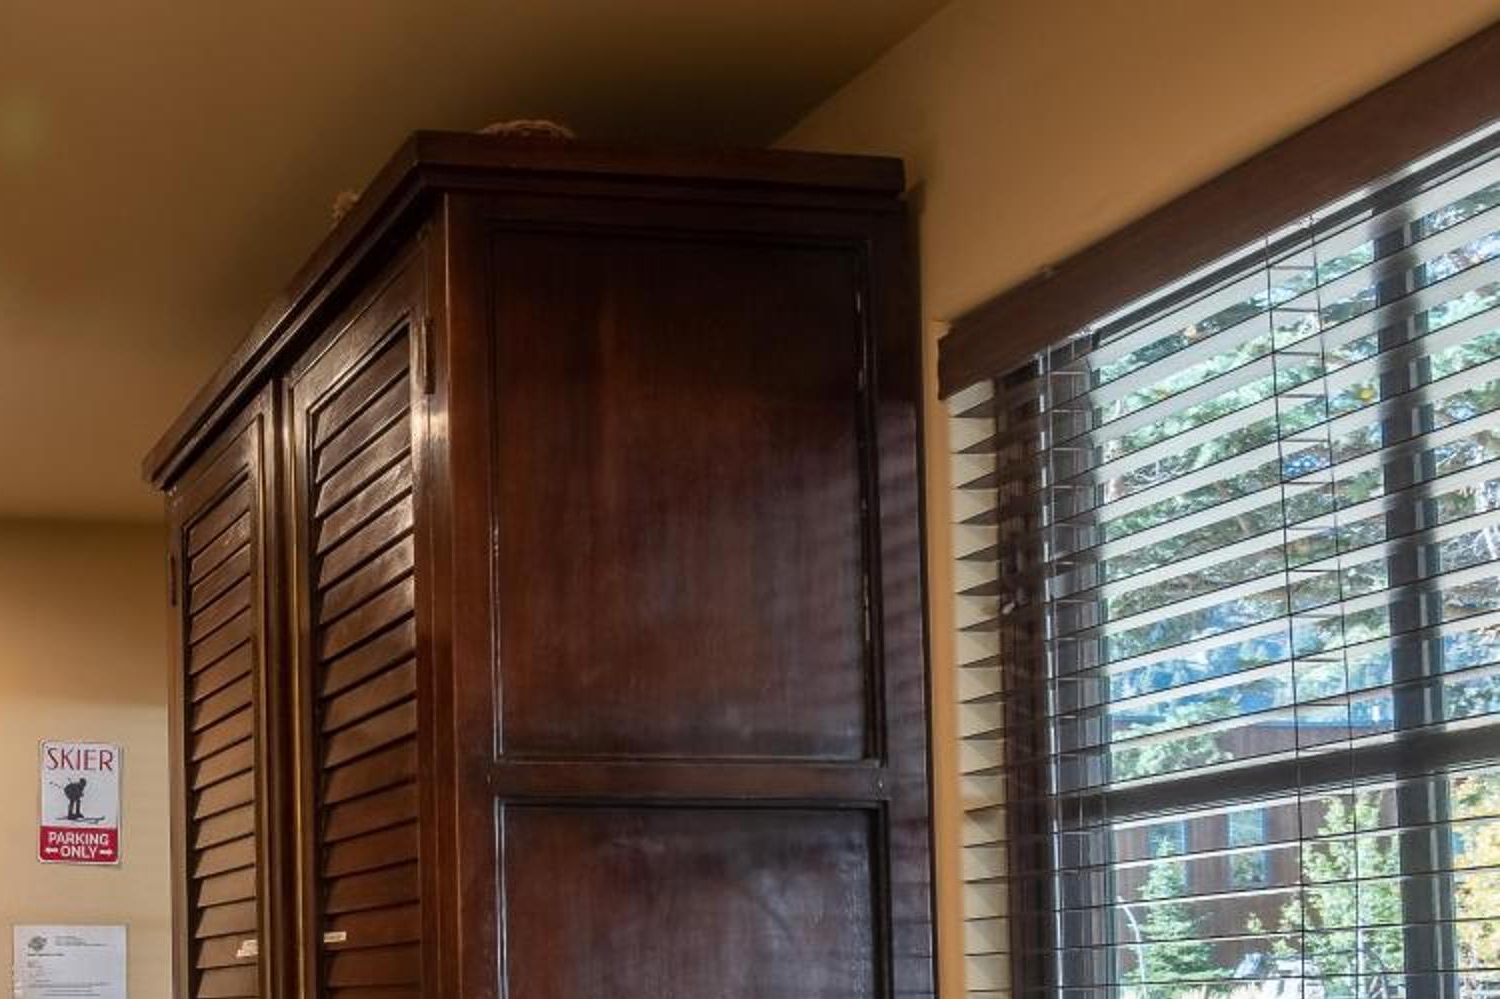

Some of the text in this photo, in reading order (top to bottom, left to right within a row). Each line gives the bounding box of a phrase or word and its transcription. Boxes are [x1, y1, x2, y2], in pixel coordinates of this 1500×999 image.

[47, 746, 114, 771] SKIER
[48, 831, 109, 846] PARKING
[60, 845, 98, 859] ONLY
